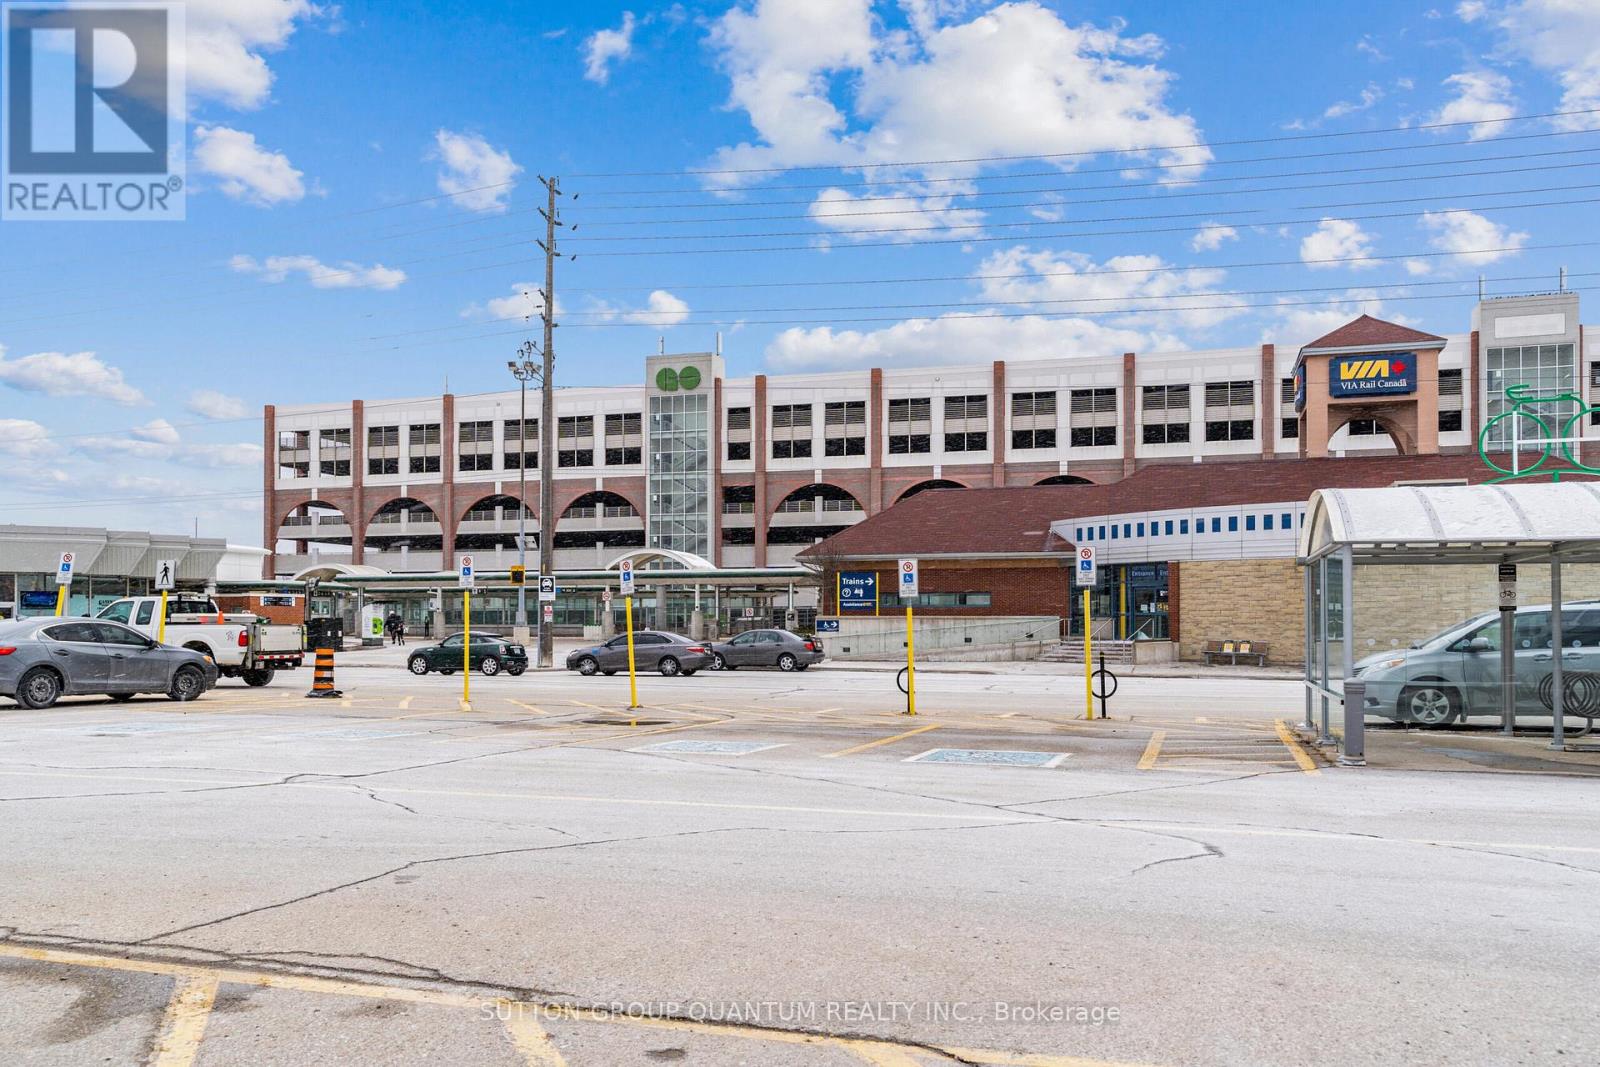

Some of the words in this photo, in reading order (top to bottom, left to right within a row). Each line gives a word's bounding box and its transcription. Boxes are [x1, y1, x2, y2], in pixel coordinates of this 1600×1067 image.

[1340, 359, 1390, 380] VIA
[1341, 381, 1358, 390] VIA
[1360, 380, 1376, 389] Rail
[1377, 378, 1407, 388] Canada
[841, 577, 865, 585] Trains
